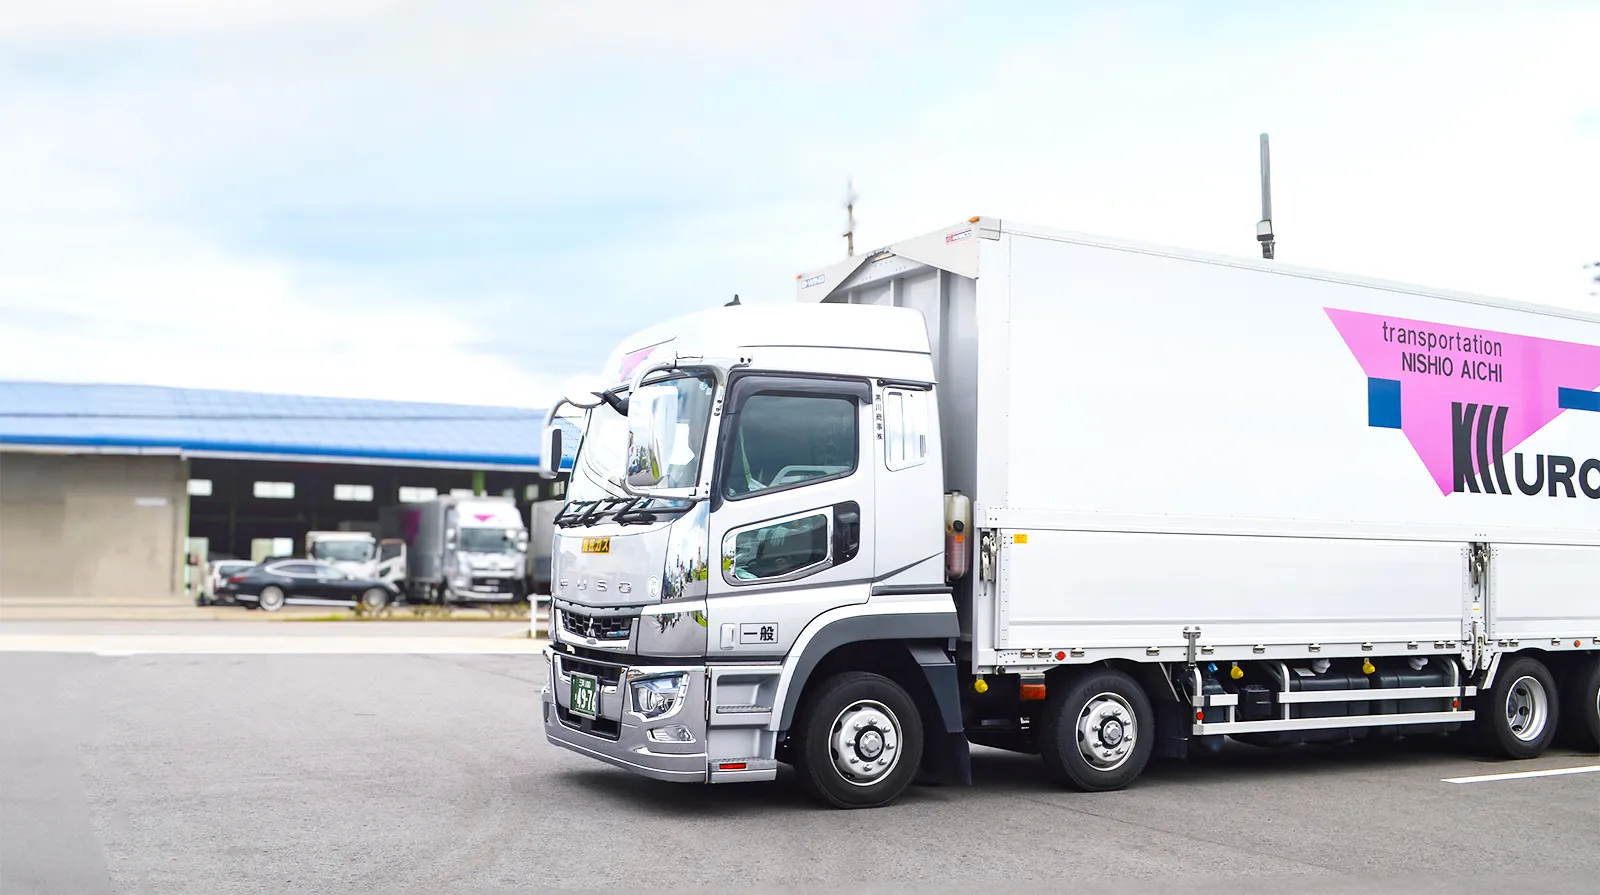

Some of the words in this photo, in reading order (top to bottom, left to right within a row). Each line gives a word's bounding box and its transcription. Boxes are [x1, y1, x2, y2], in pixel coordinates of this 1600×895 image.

[801, 275, 825, 289] D-WING
[1382, 321, 1502, 357] transportation
[1402, 352, 1454, 377] NISHIO
[1461, 360, 1503, 383] AICHI
[560, 579, 632, 594] FUSO
[743, 625, 775, 642] 一般
[576, 687, 597, 712] 49-76
